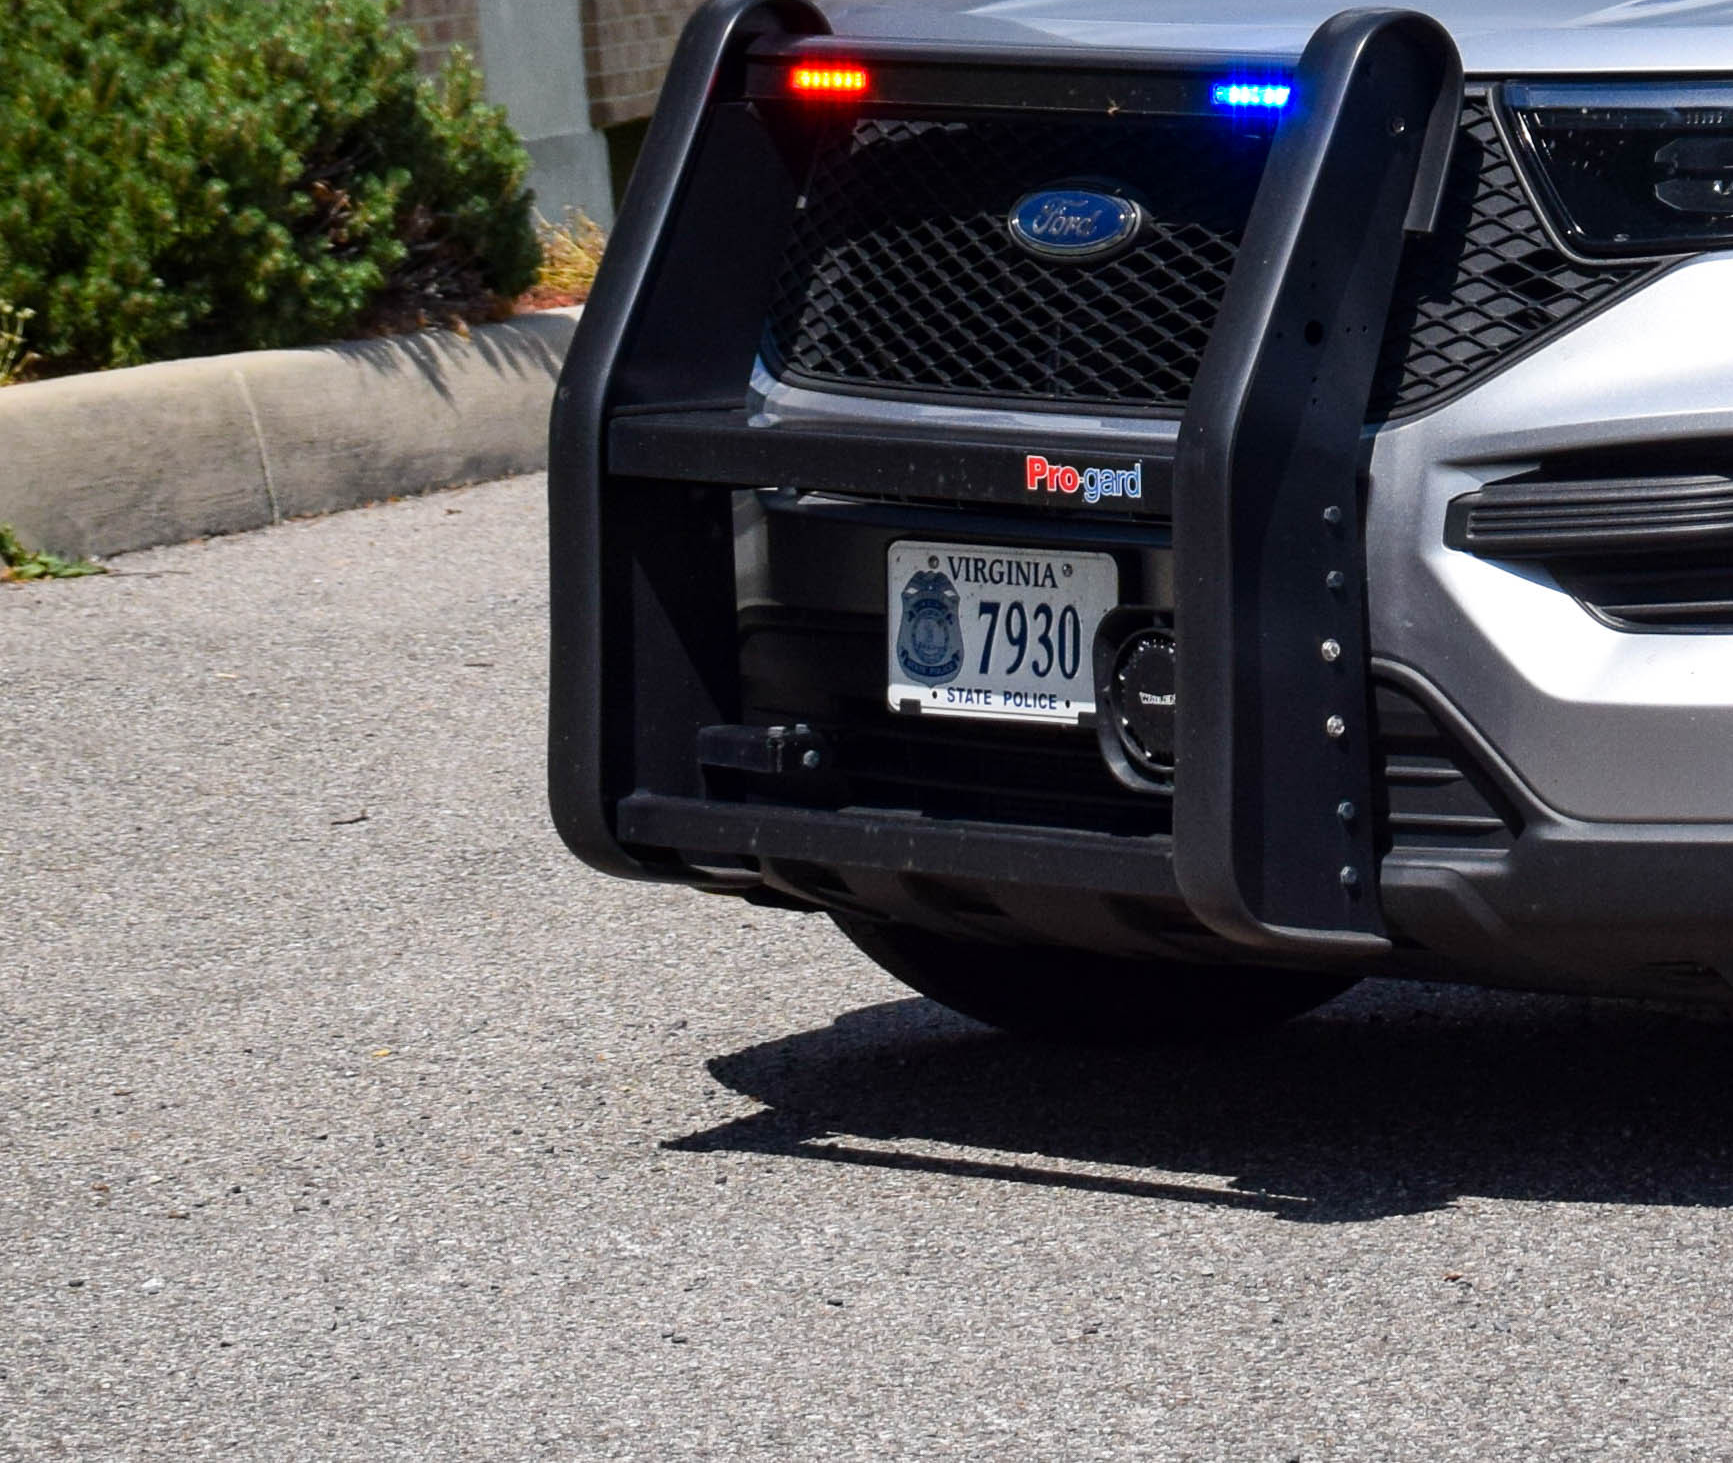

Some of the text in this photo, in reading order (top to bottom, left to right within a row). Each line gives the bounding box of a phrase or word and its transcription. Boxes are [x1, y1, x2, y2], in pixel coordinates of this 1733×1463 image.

[1032, 199, 1103, 236] Ford
[1026, 455, 1141, 503] Pro-gard
[948, 556, 1058, 588] VIRGINIA
[978, 602, 1081, 679] 7930
[947, 687, 1057, 710] STATE POLICE
